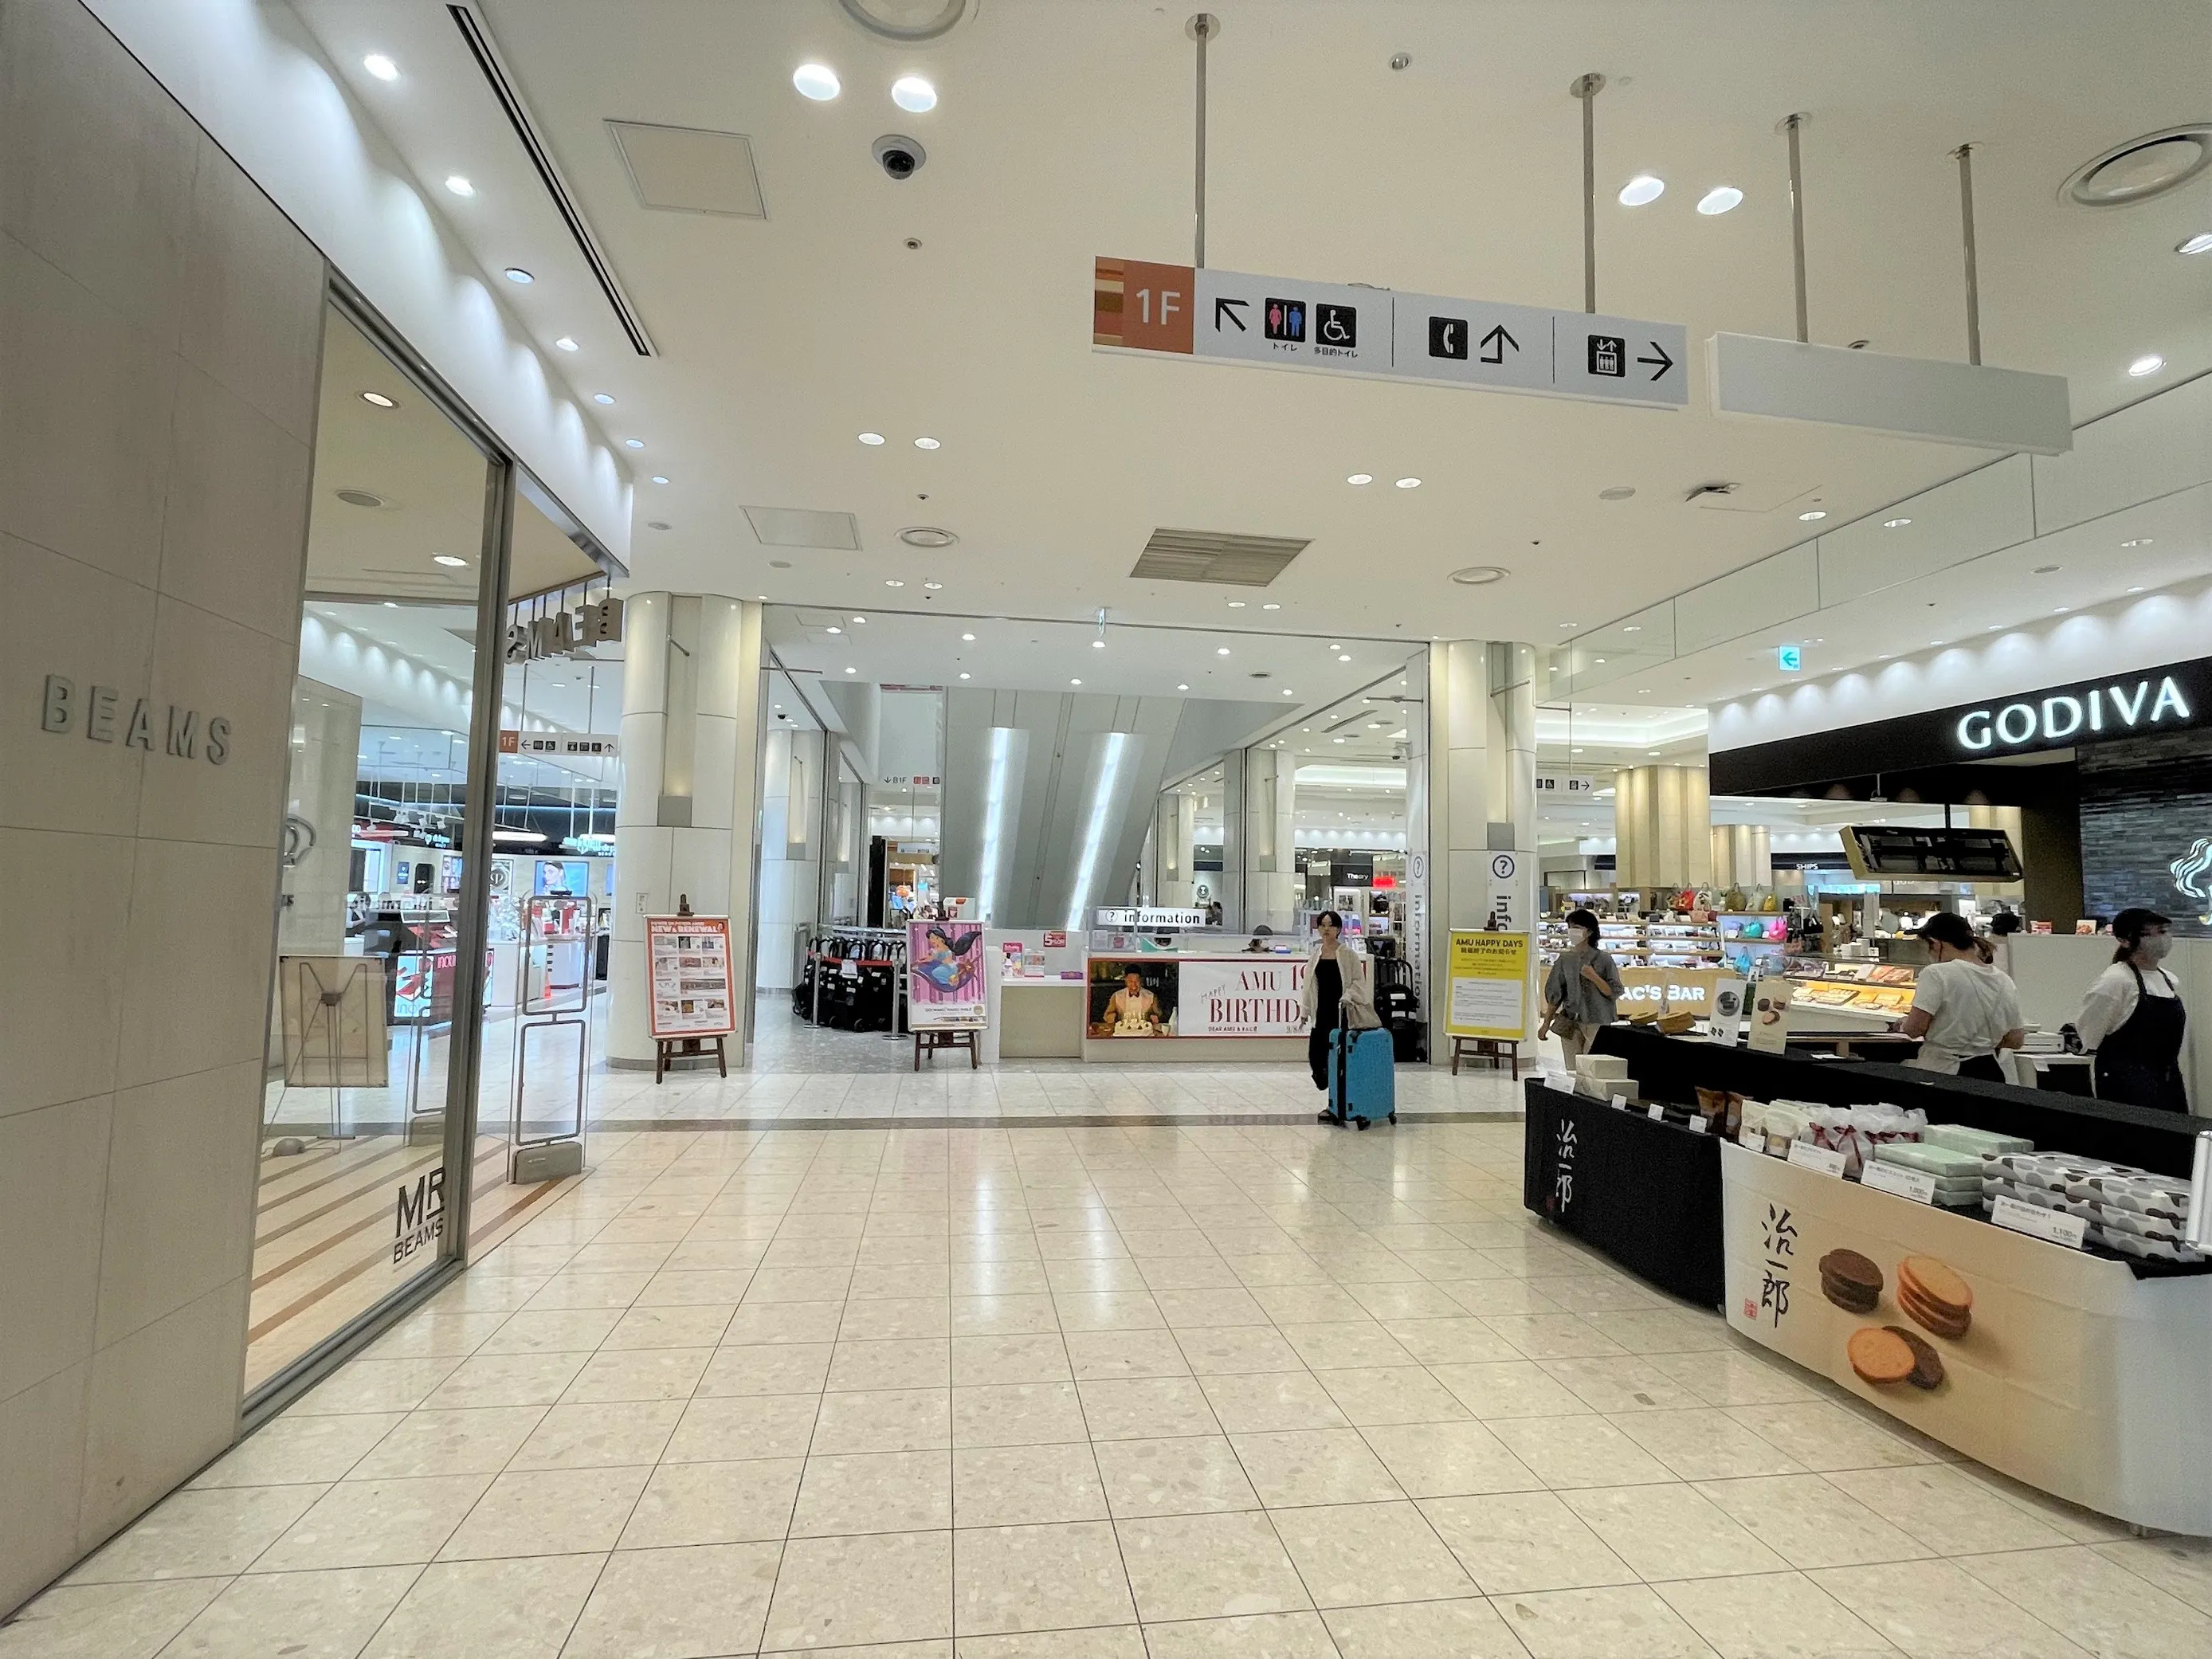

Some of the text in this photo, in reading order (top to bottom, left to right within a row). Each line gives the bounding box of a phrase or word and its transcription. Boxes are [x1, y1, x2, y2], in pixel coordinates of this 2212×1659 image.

[1136, 288, 1180, 325] 1F
[1273, 343, 1297, 351] トイレ
[1314, 347, 1359, 359] 多目的トイレ
[41, 674, 232, 765] BEAMS
[1957, 676, 2190, 750] GODIVA
[501, 736, 515, 747] 1F
[1124, 911, 1200, 924] information
[1234, 971, 1281, 991] AMU
[1619, 984, 1705, 1001] AC'S BAR
[1210, 998, 1300, 1023] BIRTHD
[1555, 1119, 1578, 1212] 治一郎
[395, 1167, 446, 1238] MR
[394, 1218, 443, 1264] BEAMS
[1760, 1202, 1798, 1328] 治一郎
